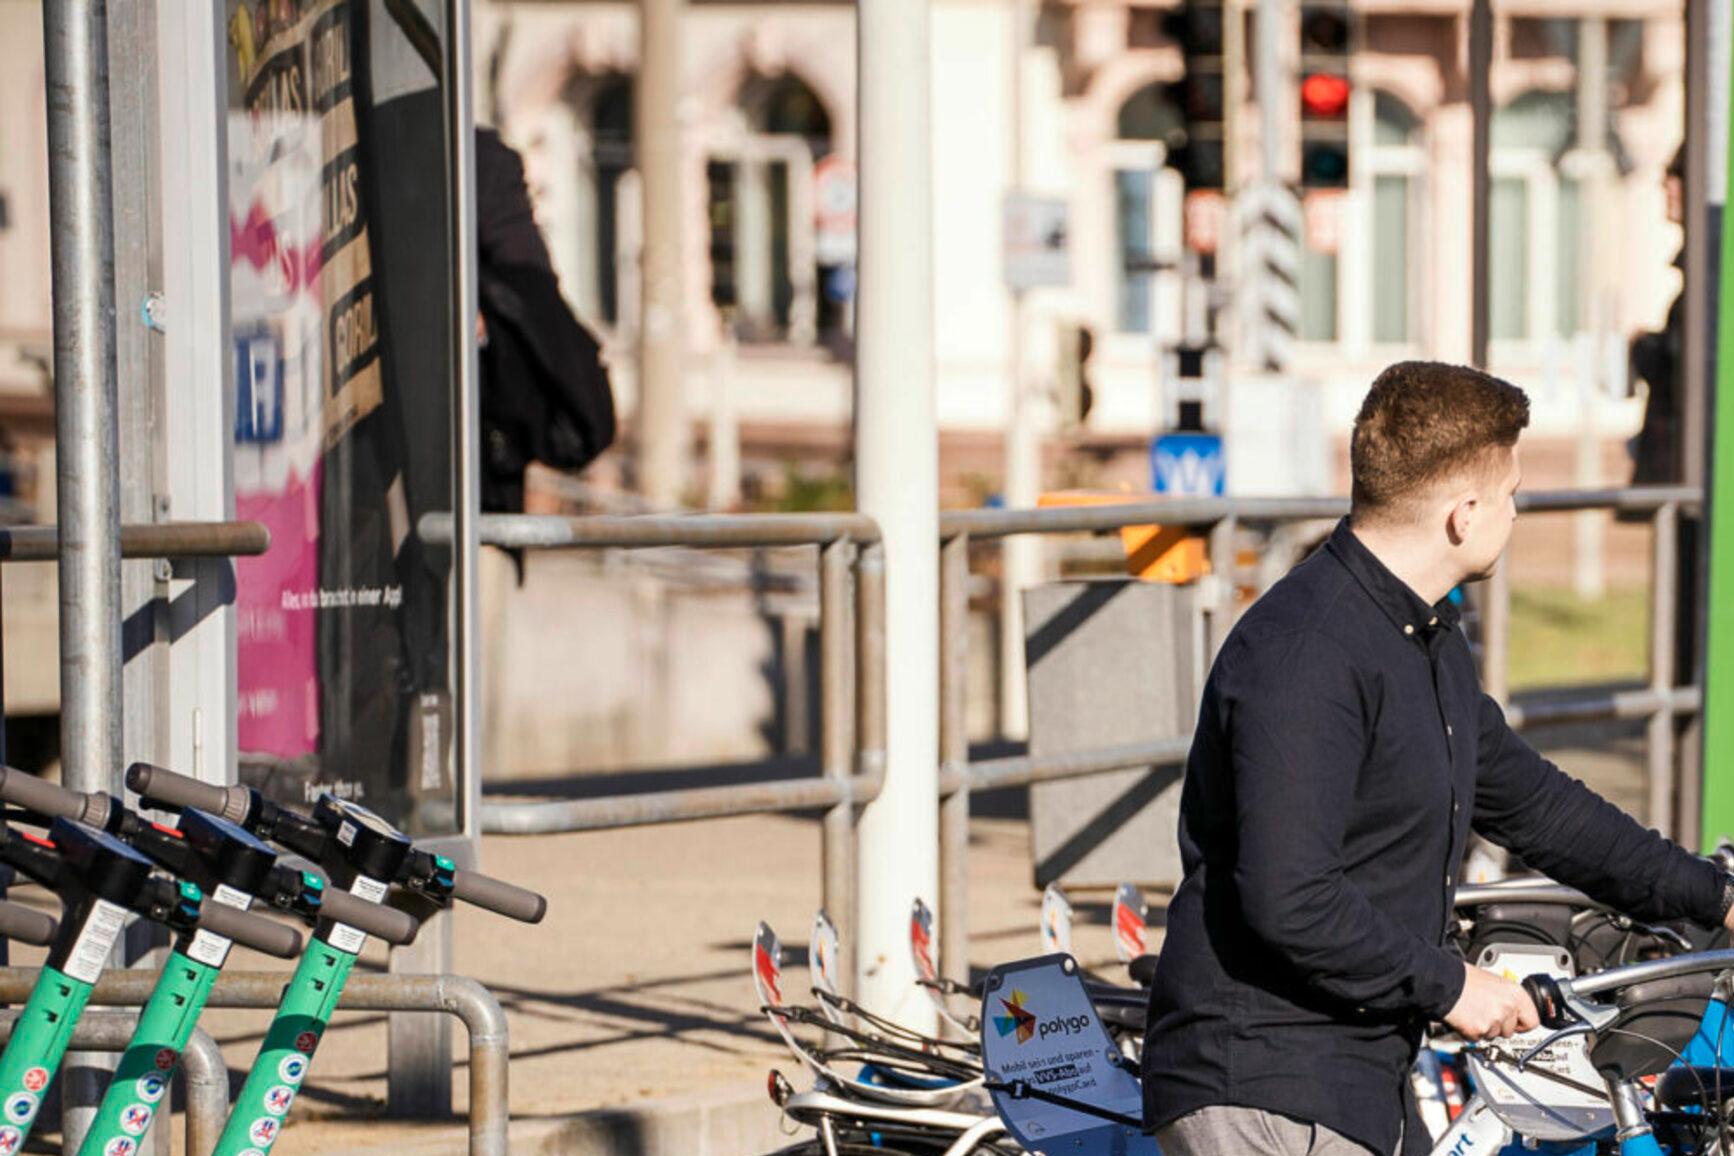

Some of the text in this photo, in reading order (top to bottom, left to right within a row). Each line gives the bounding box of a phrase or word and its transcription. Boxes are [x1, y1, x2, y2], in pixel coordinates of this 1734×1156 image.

[1039, 1014, 1090, 1040] polygo
[1001, 1061, 1027, 1074] Mobil
[1047, 1053, 1065, 1065] und
[1065, 1048, 1094, 1061] sparen
